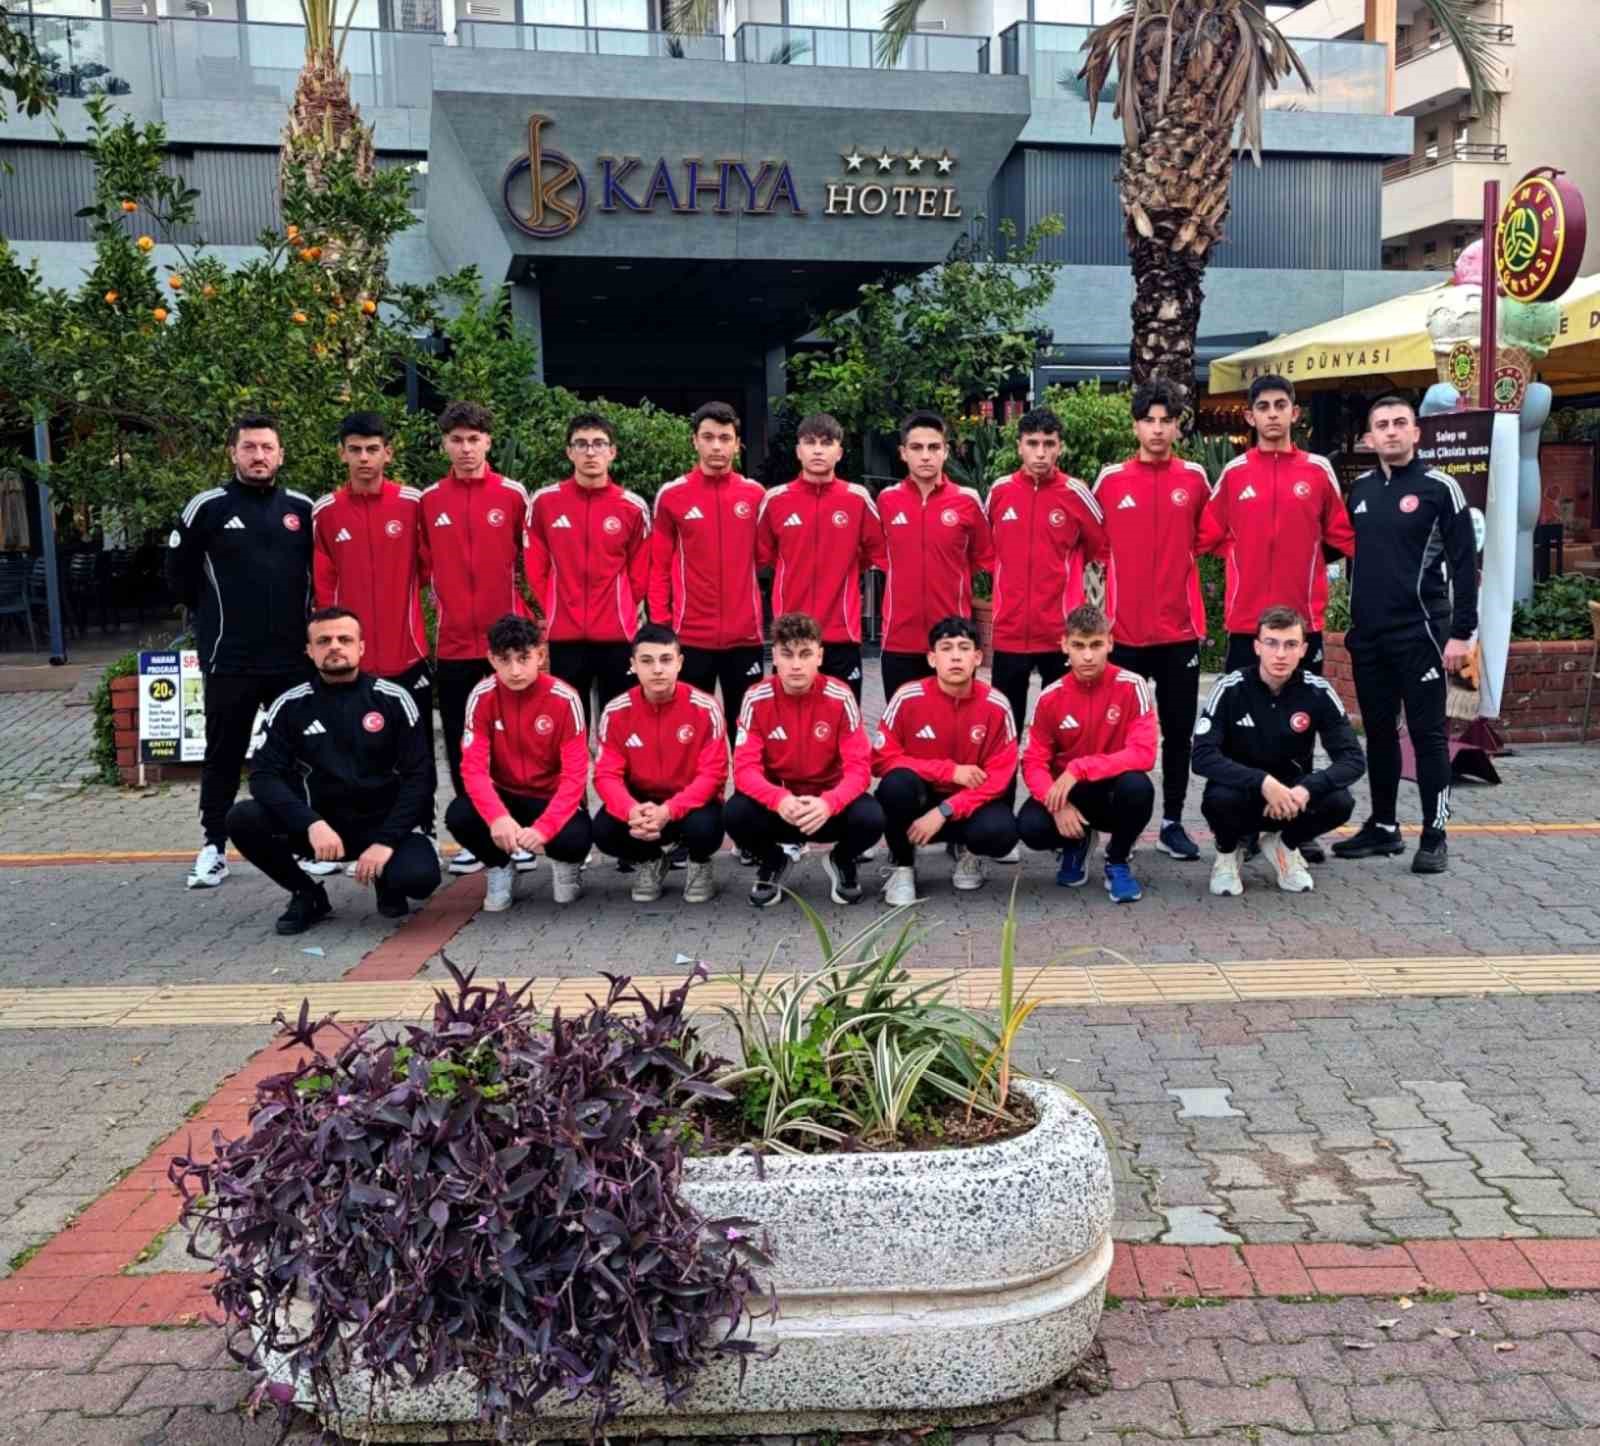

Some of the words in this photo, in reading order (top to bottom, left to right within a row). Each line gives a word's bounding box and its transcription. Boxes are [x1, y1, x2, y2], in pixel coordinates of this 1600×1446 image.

[599, 157, 807, 215] KAHYA
[825, 182, 962, 218] HOTEL
[1240, 360, 1295, 384] KAHVE
[1306, 348, 1391, 371] DÜNYASI
[1467, 445, 1489, 456] varsa
